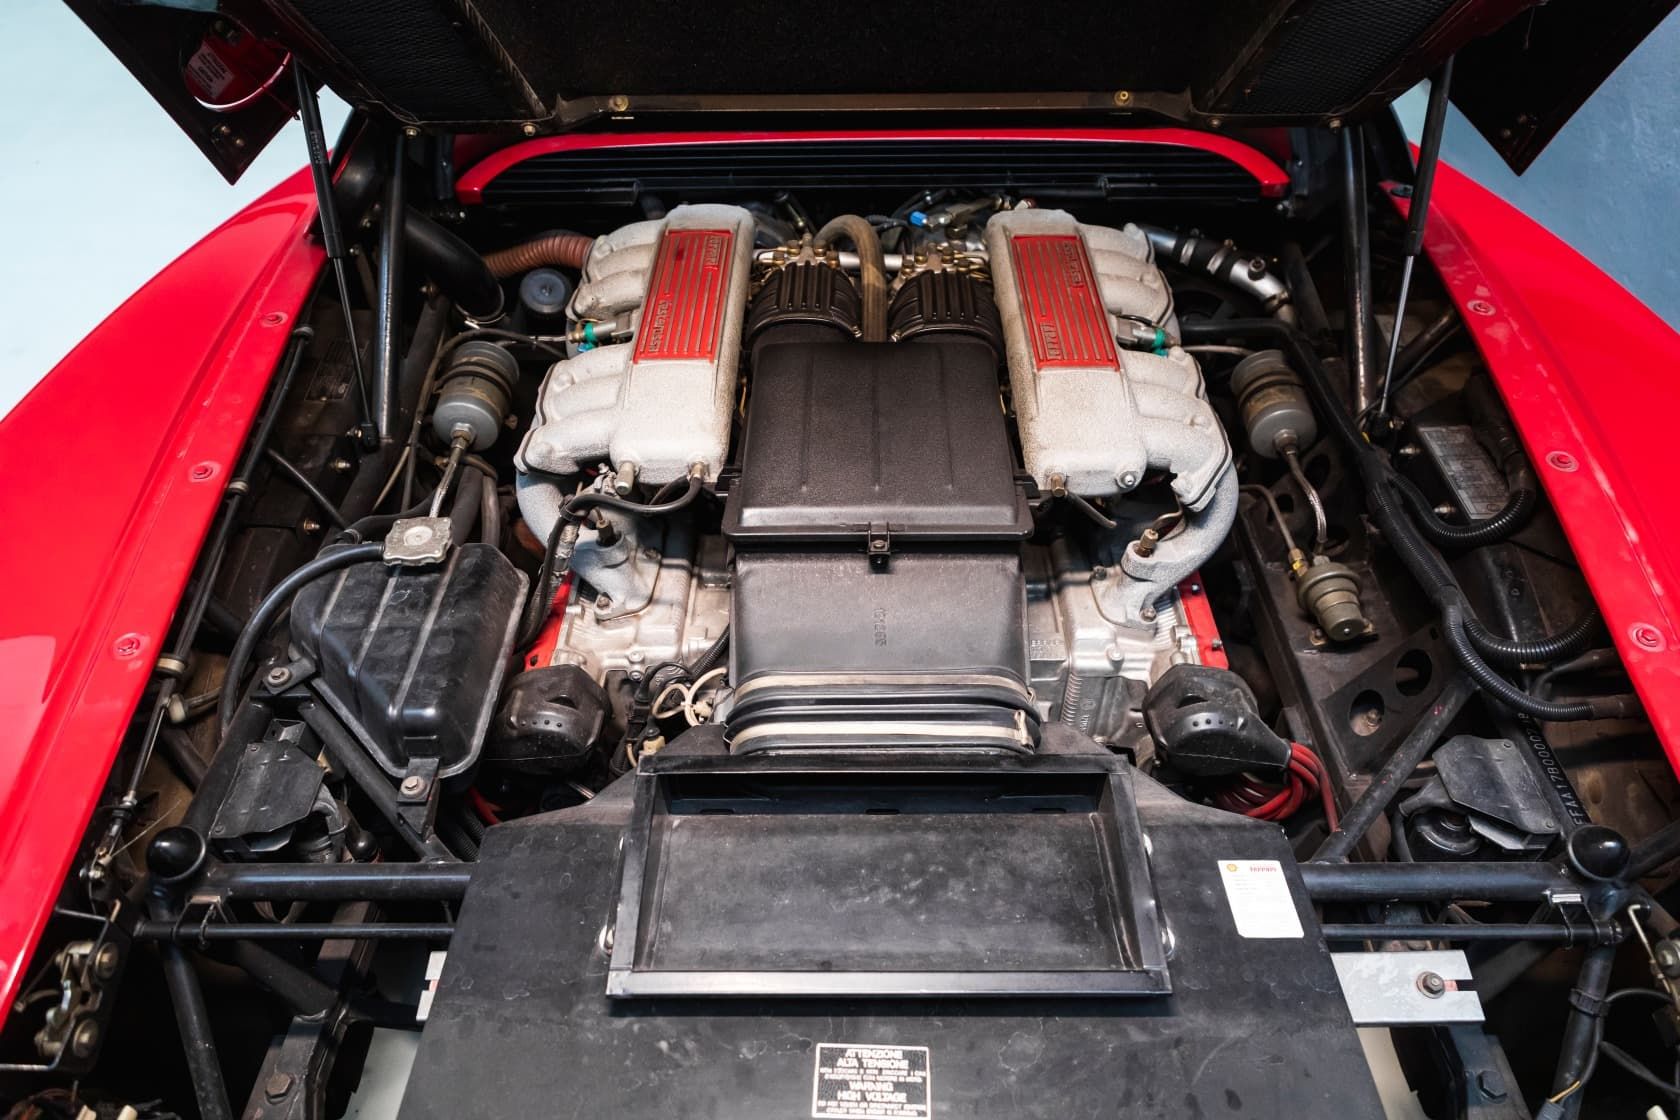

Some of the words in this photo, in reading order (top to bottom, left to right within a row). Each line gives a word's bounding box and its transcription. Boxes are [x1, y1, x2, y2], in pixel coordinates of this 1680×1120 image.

[845, 1048, 903, 1060] ATTENZIONE
[836, 1057, 859, 1068] ALTA
[862, 1059, 909, 1070] TENSIONE
[848, 1080, 894, 1092] WARNING
[836, 1090, 861, 1101] HIGH
[864, 1092, 908, 1103] VOLTAGE
